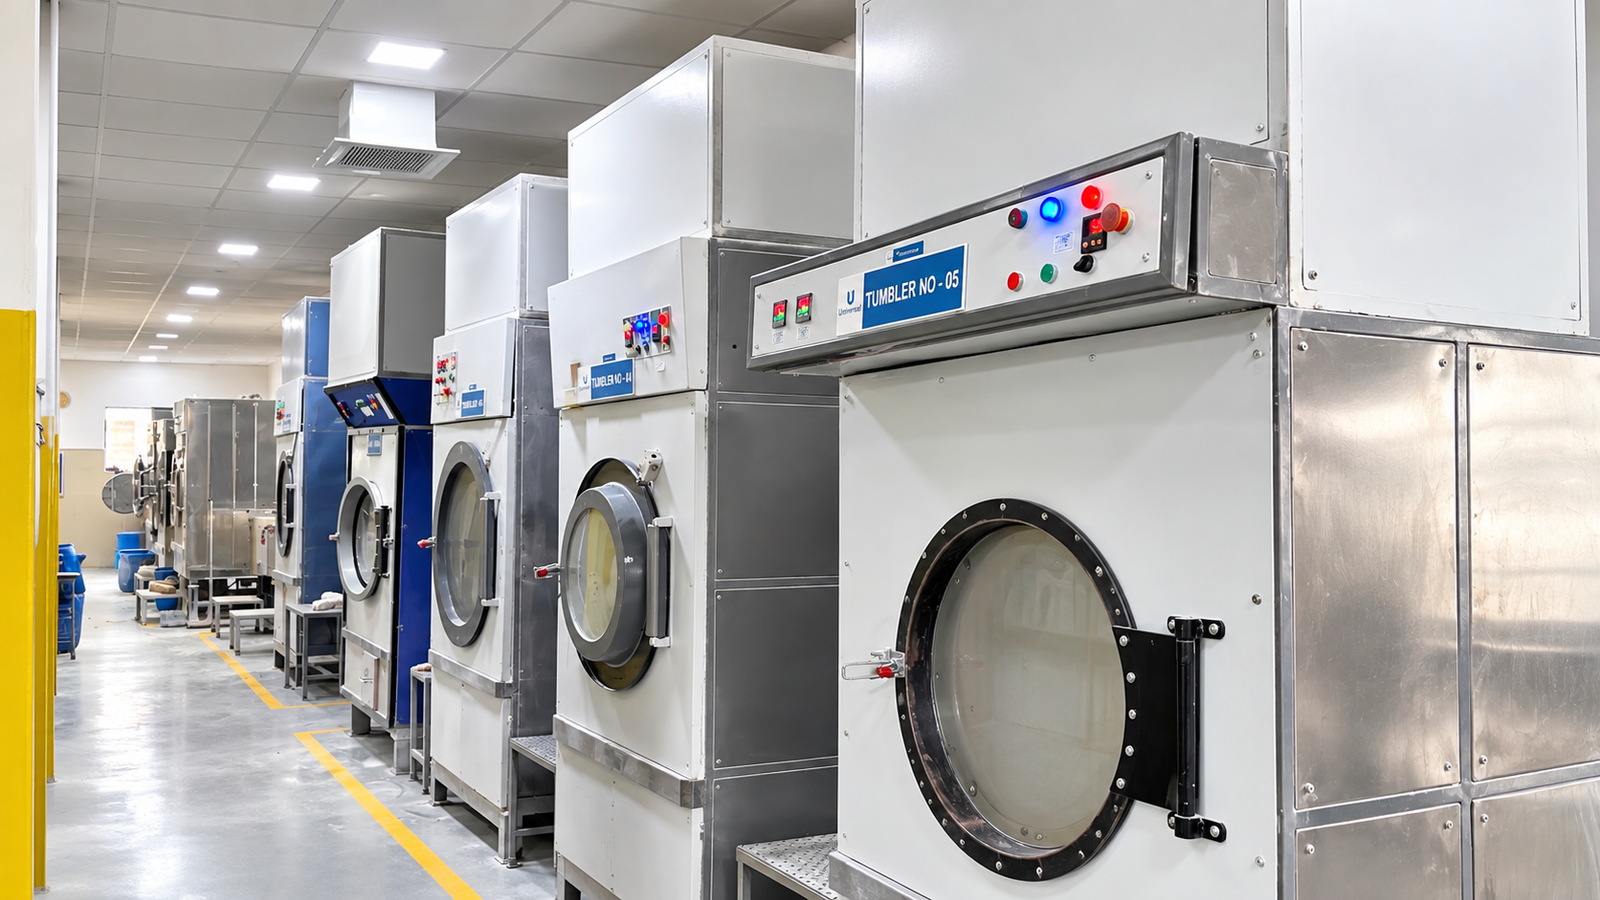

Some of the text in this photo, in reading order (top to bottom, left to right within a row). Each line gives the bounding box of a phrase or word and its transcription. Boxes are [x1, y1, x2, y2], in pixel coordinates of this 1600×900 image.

[865, 280, 916, 308] TUMBLER
[919, 275, 936, 296] NO
[945, 269, 960, 290] 05
